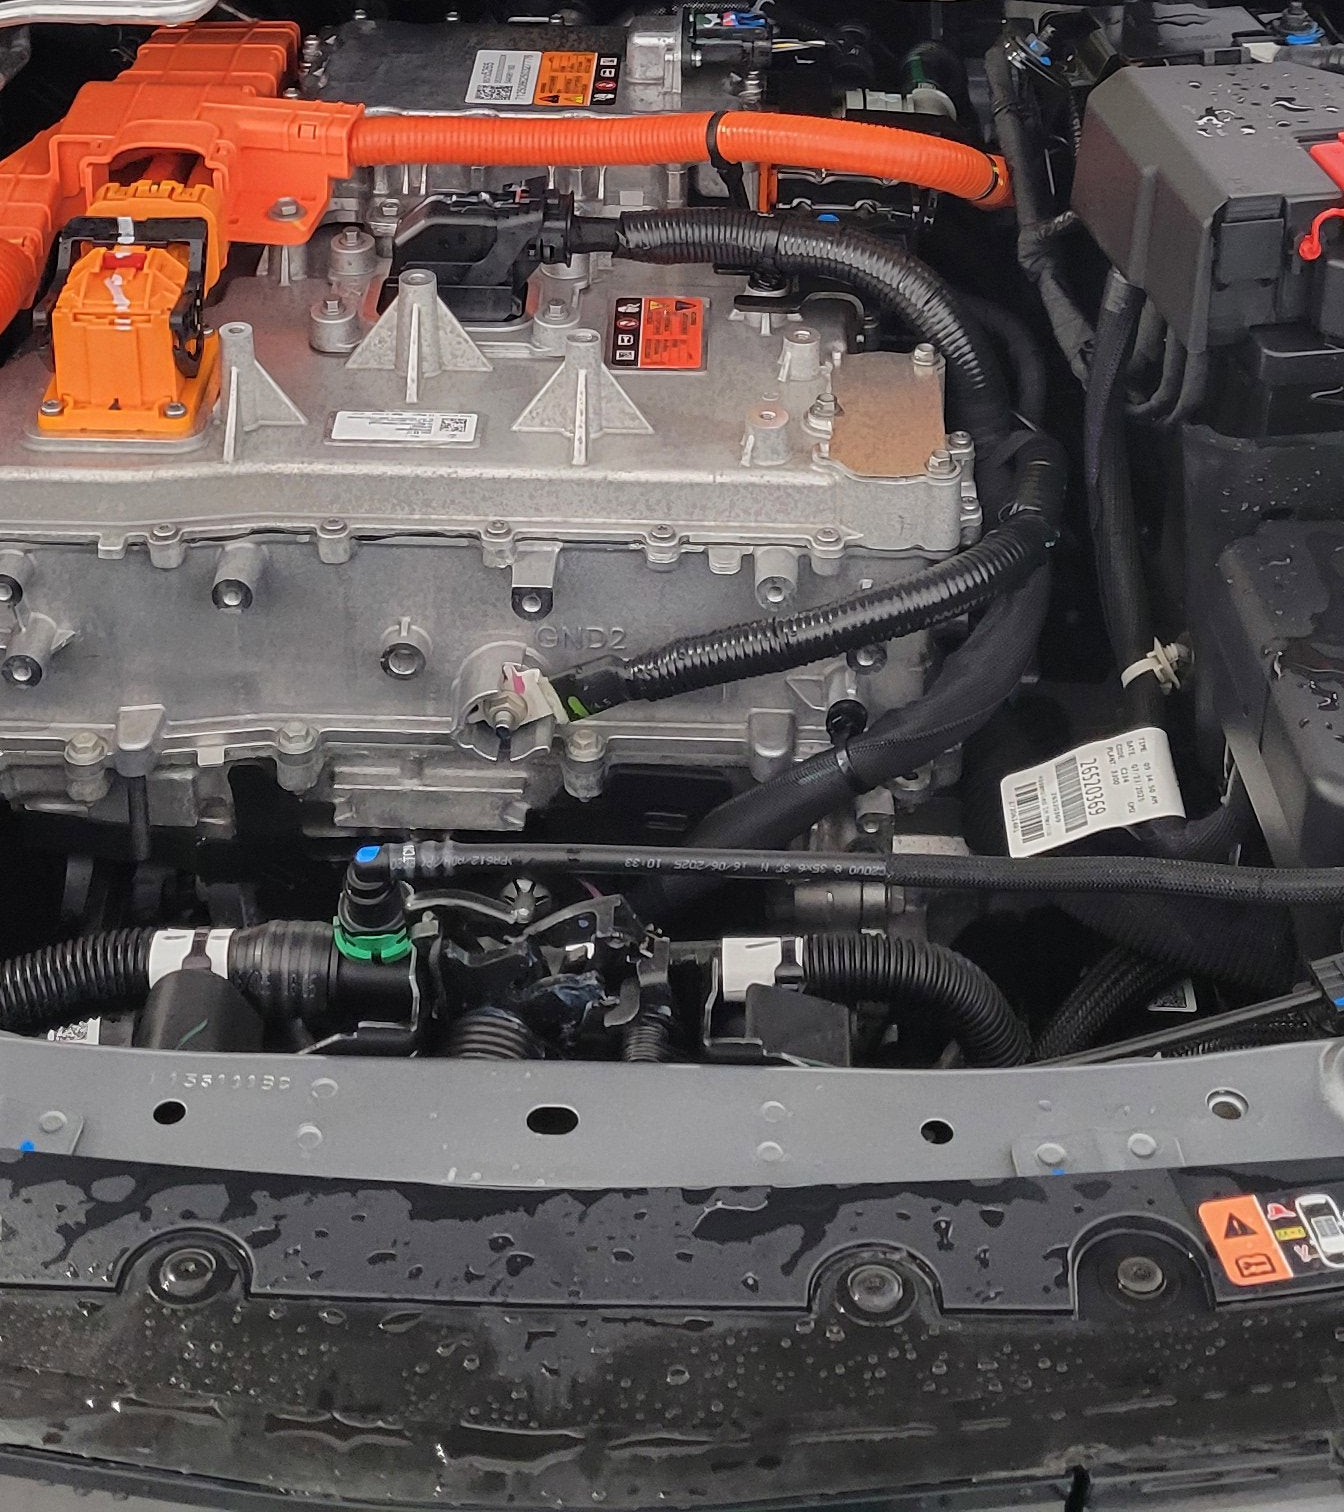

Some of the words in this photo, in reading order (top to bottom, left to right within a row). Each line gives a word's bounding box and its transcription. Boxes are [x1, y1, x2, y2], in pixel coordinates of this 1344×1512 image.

[536, 626, 627, 650] GND2
[1106, 746, 1116, 765] PLANT
[1080, 757, 1106, 817] 26520369
